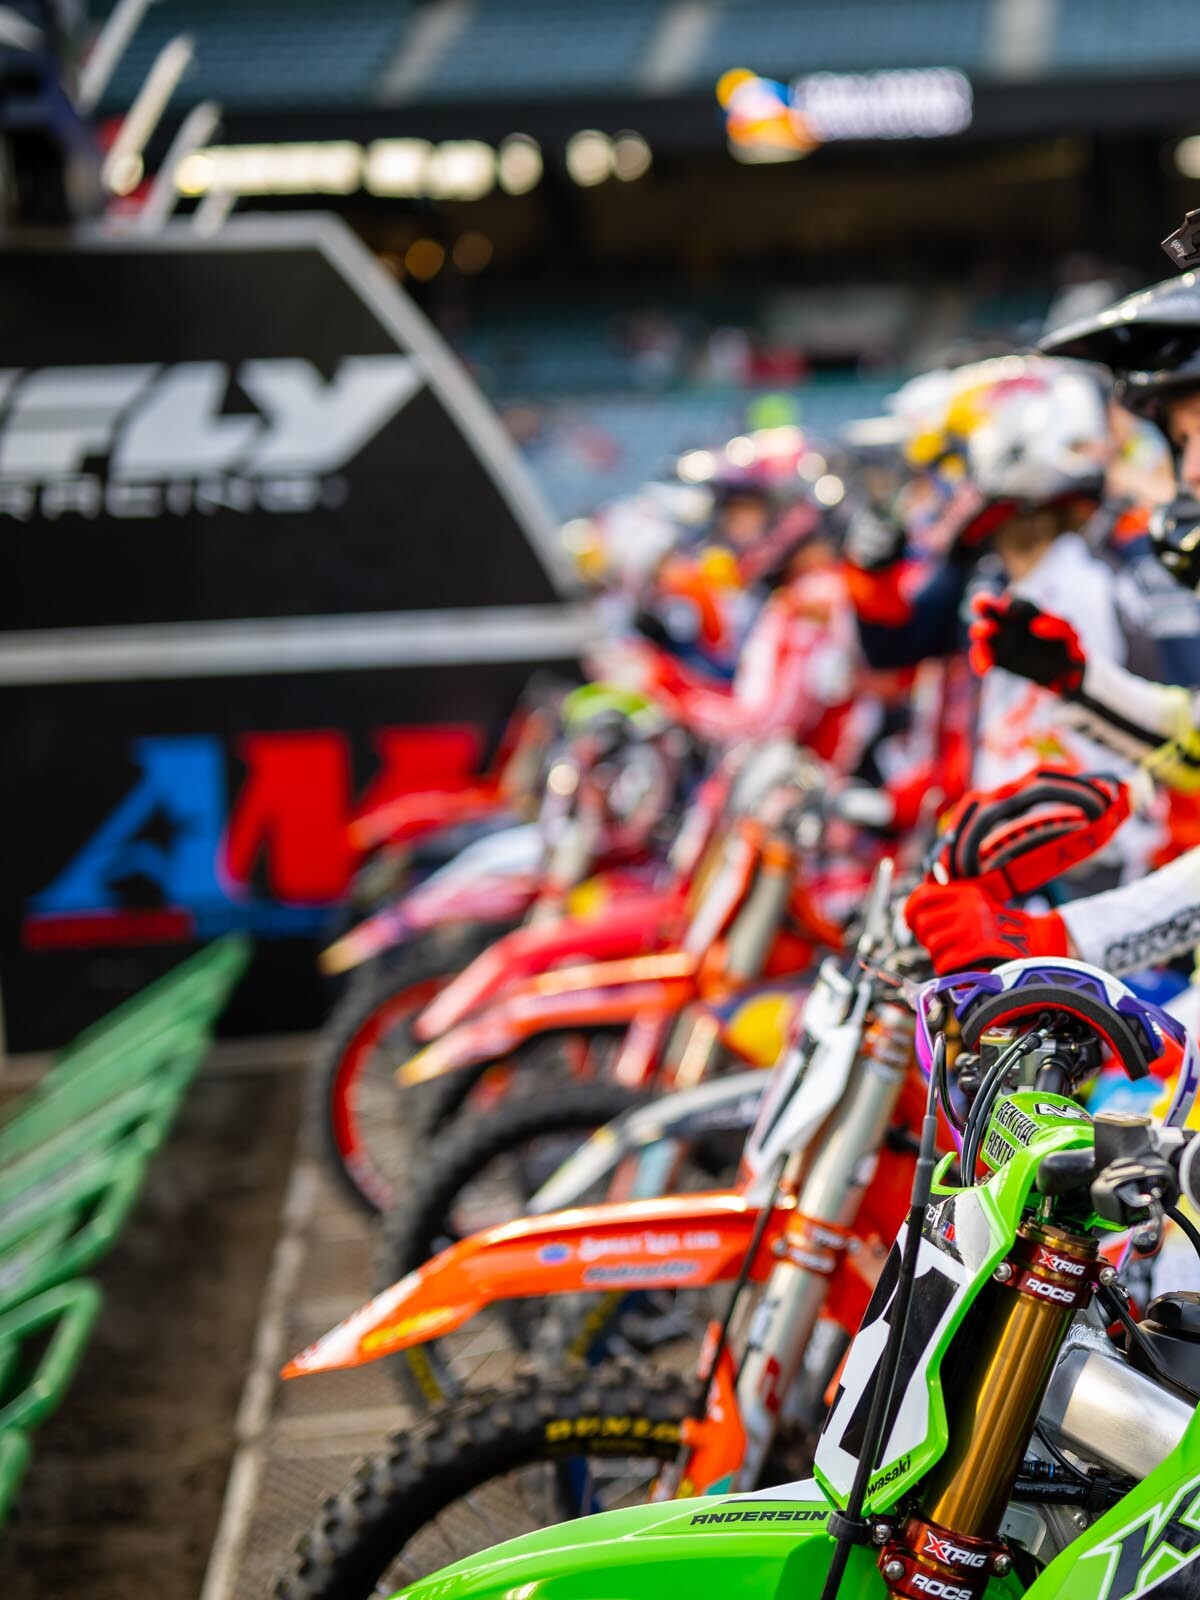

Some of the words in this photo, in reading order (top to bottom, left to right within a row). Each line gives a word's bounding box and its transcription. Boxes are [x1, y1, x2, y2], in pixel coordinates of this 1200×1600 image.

[2, 353, 426, 482] FLY
[1040, 1248, 1087, 1276] XTRIG
[1025, 1276, 1076, 1304] ROCS
[867, 1455, 912, 1498] wasaki
[689, 1510, 829, 1526] ANDERSON
[923, 1529, 989, 1569] XTRIG
[910, 1572, 973, 1600] ROCS
